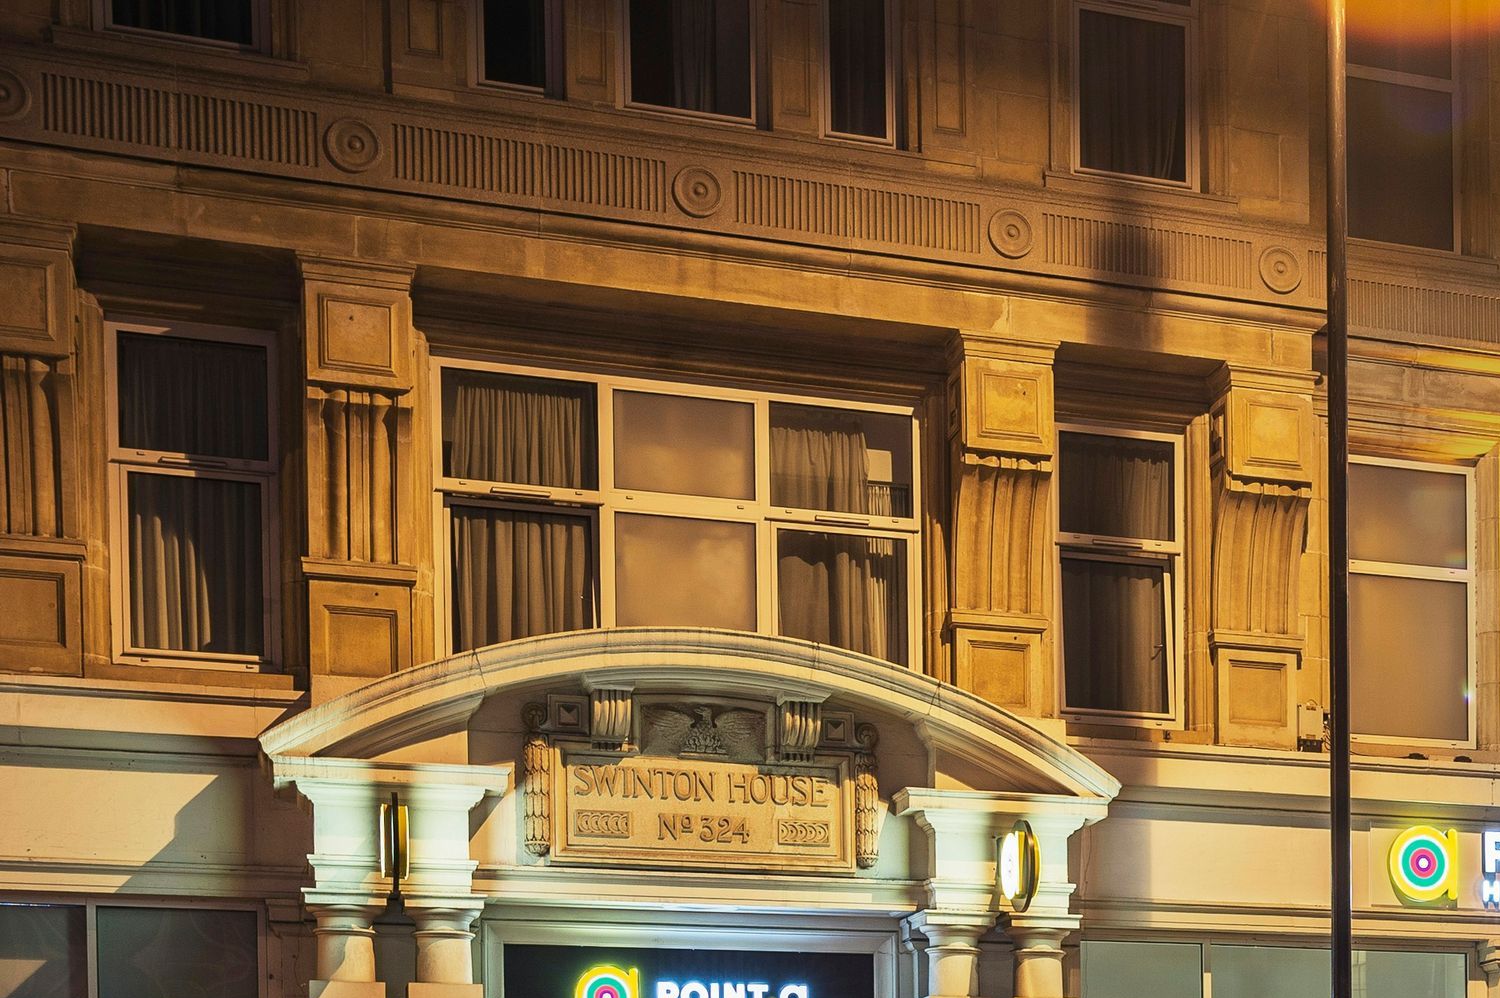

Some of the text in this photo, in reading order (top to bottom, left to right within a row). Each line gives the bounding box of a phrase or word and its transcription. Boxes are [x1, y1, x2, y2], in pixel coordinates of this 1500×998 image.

[573, 764, 830, 808] SWINTON HOUSE
[699, 816, 750, 844] 324
